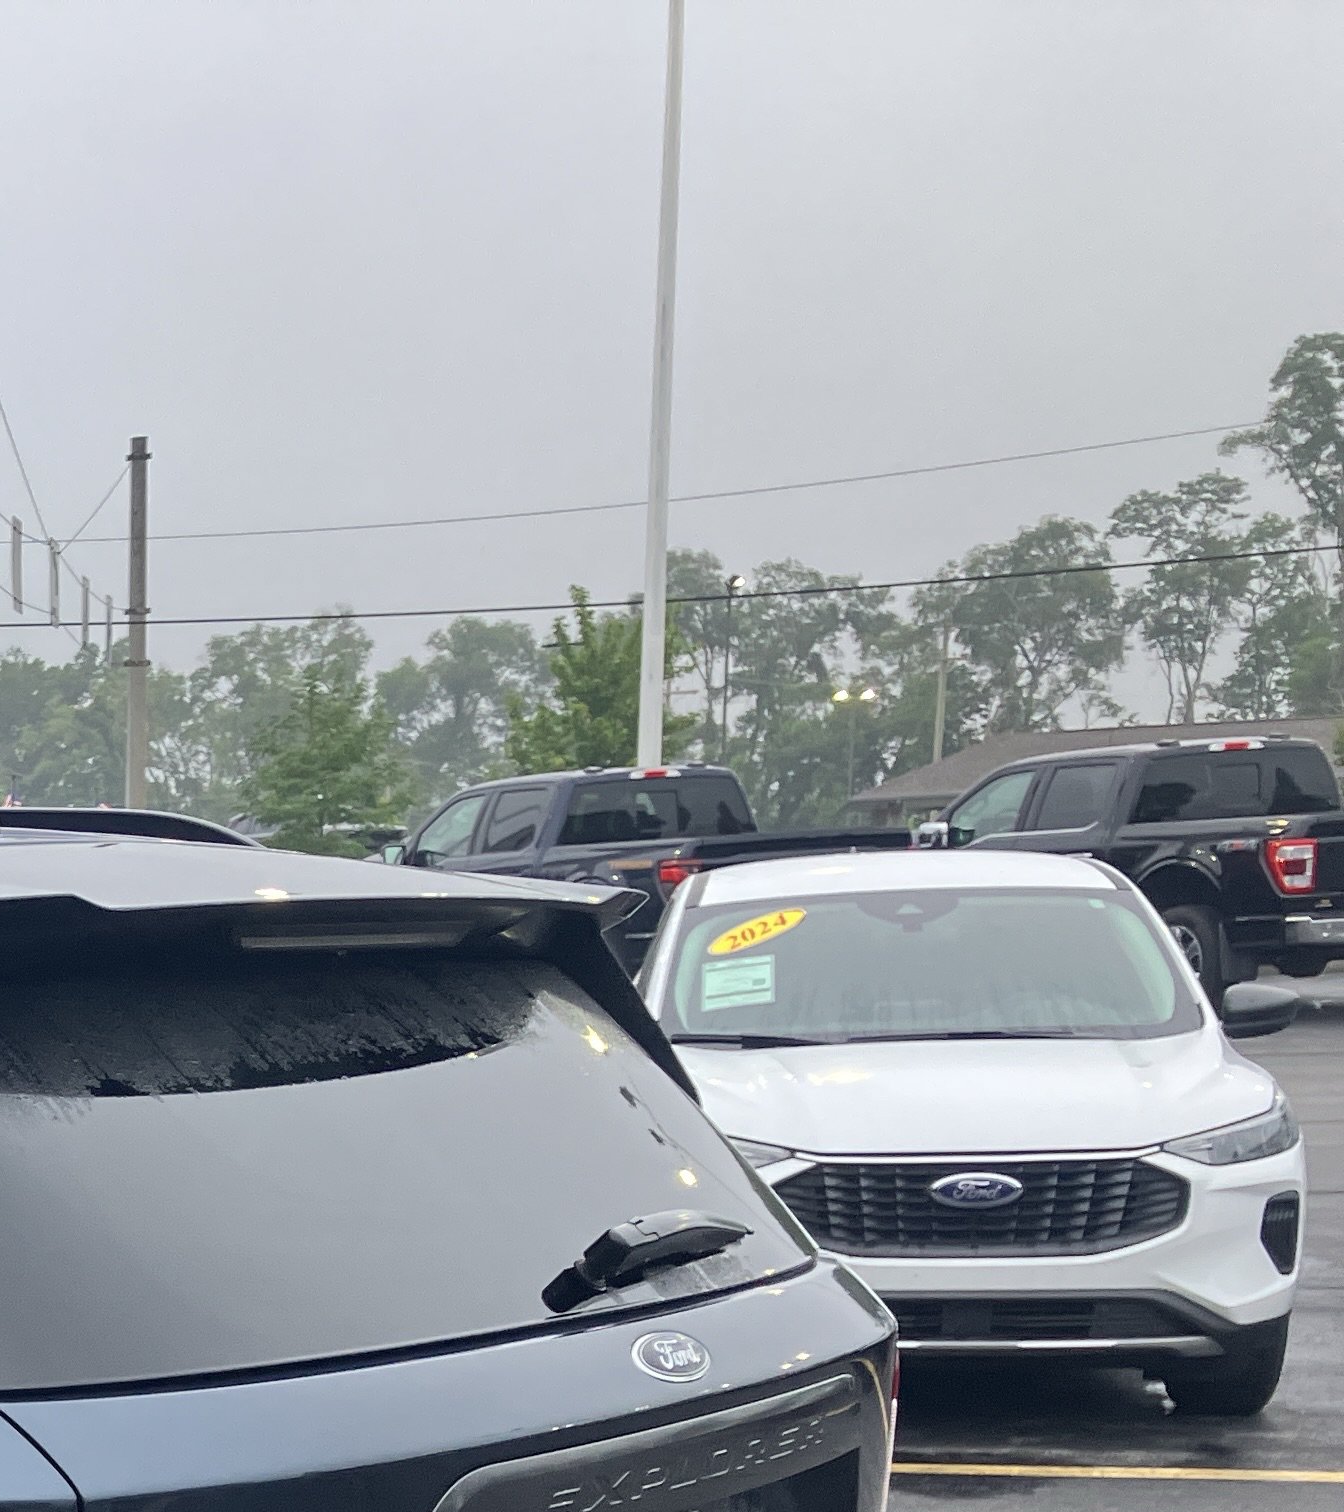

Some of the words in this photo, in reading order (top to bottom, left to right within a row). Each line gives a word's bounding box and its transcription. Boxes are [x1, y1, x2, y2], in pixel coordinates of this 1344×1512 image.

[727, 912, 787, 950] 2024
[953, 1180, 1004, 1200] Ford
[653, 1338, 705, 1370] Ford
